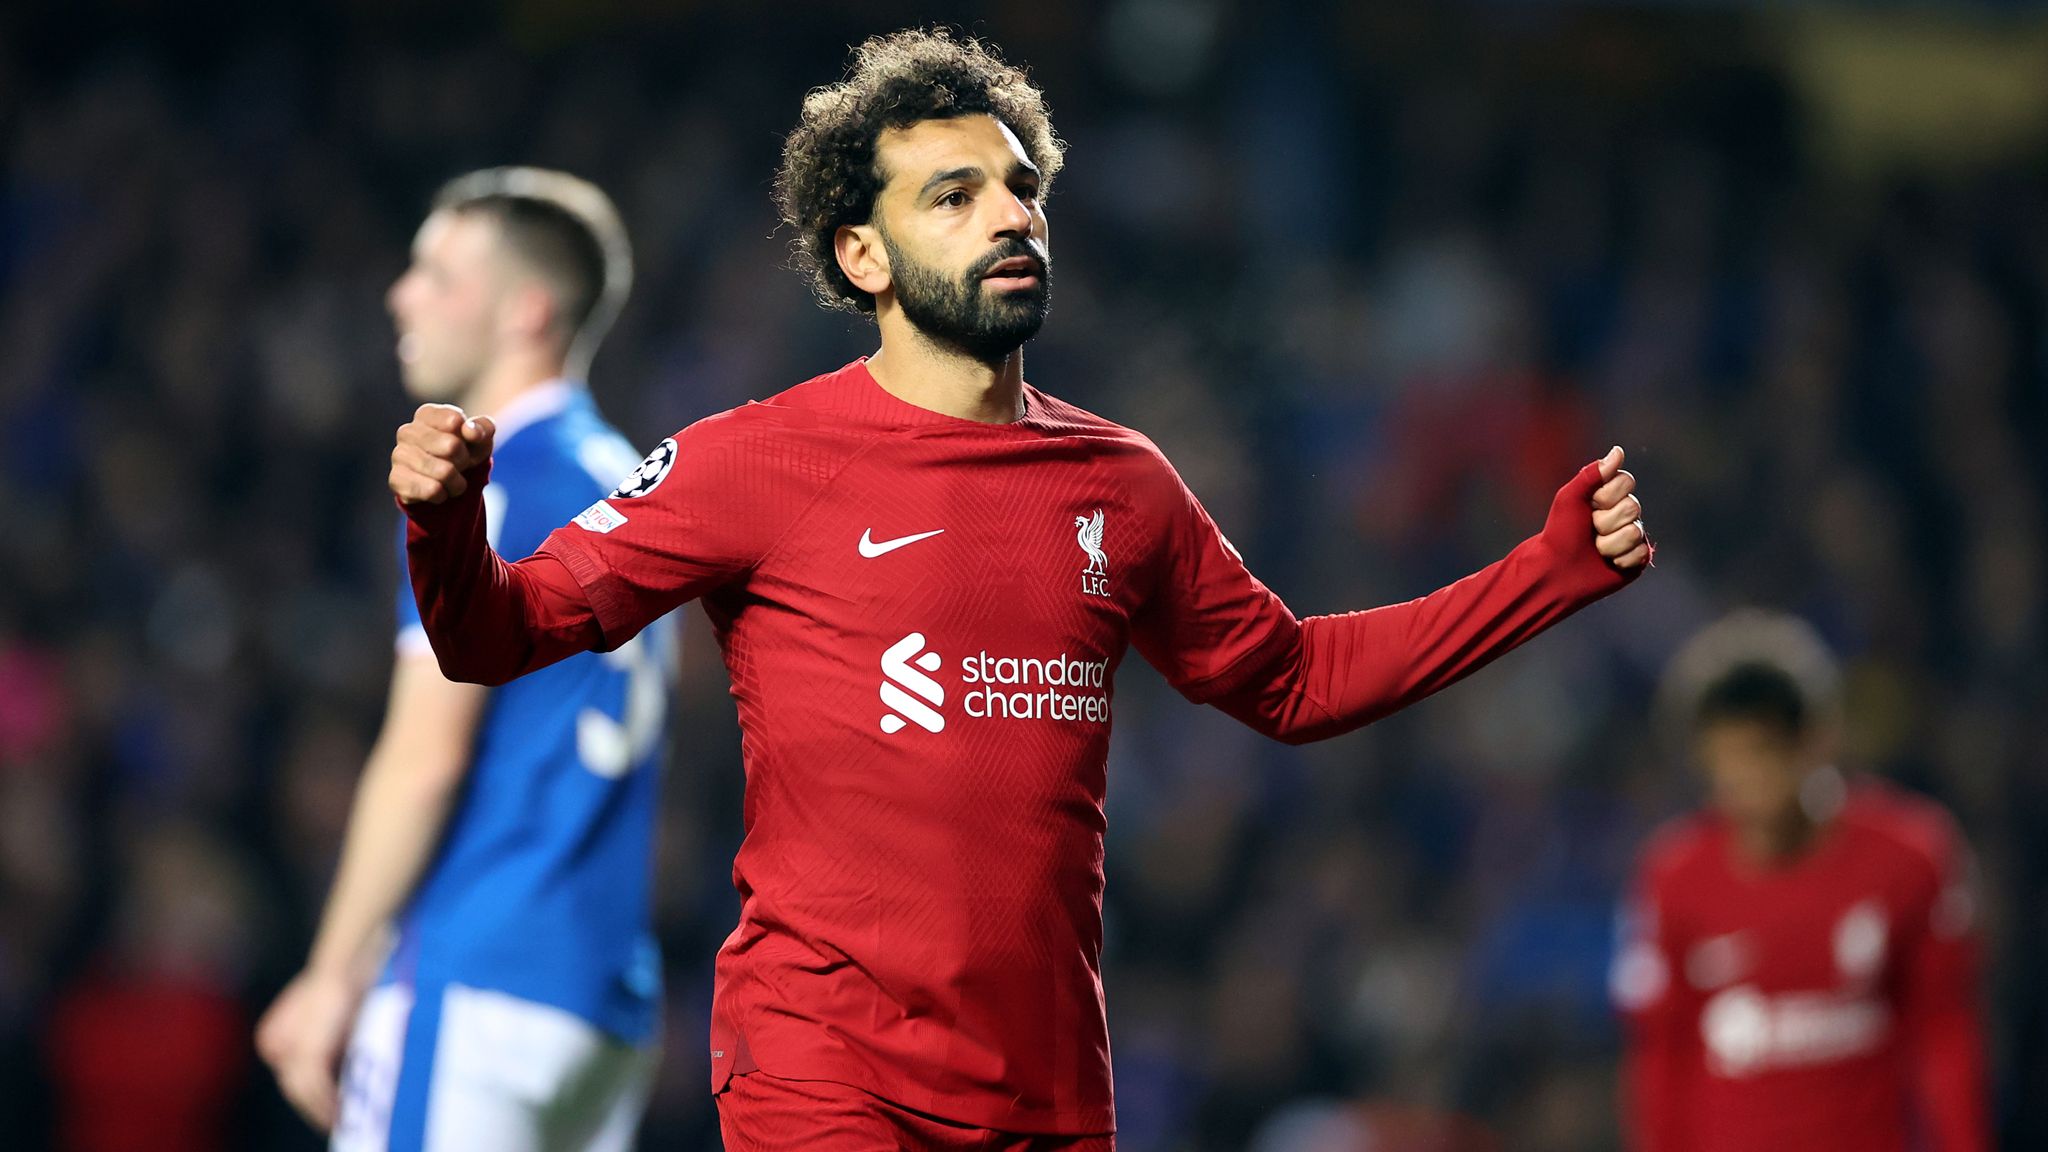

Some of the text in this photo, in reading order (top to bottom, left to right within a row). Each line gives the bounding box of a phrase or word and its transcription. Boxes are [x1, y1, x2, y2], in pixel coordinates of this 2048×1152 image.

[1082, 575, 1110, 597] L.F.C.
[962, 650, 1109, 688] standard
[964, 685, 1108, 723] chartered
